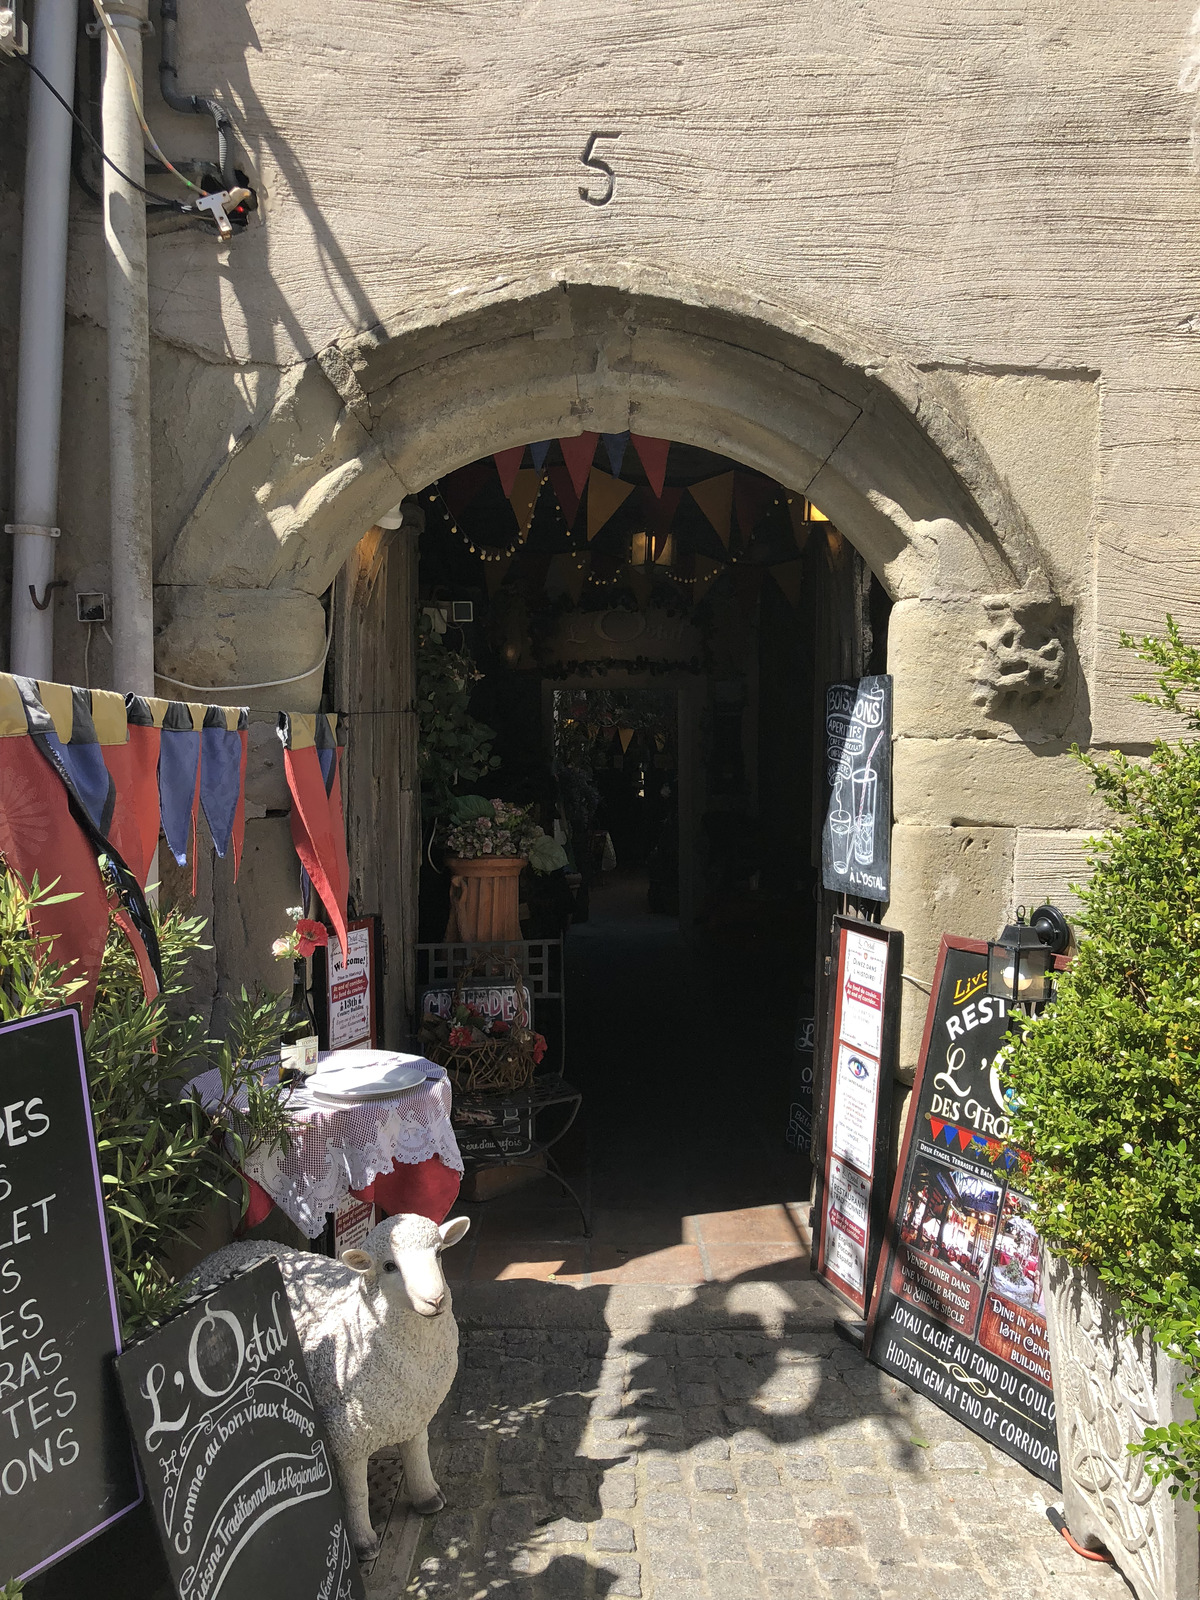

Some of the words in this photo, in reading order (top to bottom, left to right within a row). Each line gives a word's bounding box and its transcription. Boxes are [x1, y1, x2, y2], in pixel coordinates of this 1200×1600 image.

[578, 131, 623, 207] 5
[334, 956, 366, 972] Wecome!
[344, 996, 358, 1009] 13th
[0, 1098, 50, 1147] ES
[930, 1094, 961, 1121] DES
[833, 1183, 867, 1207] RESTAURANT
[901, 1265, 915, 1280] UNE
[916, 1273, 942, 1295] VIEILLE
[942, 1288, 971, 1311] BÂTISSE
[907, 1250, 928, 1271] VENEZ
[929, 1264, 950, 1284] DINER
[951, 1276, 971, 1294] DANS
[902, 1282, 913, 1295] DU
[940, 1304, 965, 1325] SIÈCLE
[990, 1297, 1016, 1323] DINE
[1016, 1315, 1027, 1329] IN
[1028, 1322, 1042, 1338] AN
[890, 1301, 923, 1335] JOYAU
[922, 1322, 956, 1356] CACHÉ
[953, 1343, 970, 1365] AU
[970, 1353, 999, 1385] FOND
[999, 1371, 1018, 1396] DU
[1018, 1383, 1057, 1421] COULO
[999, 1321, 1022, 1345] 13TH
[1023, 1336, 1051, 1361] CENT
[140, 1290, 290, 1453] L'Ostal
[1010, 1349, 1051, 1382] BUILDING
[2, 1377, 77, 1439] TES
[886, 1339, 923, 1375] HIDDEN
[922, 1367, 945, 1395] GEM
[944, 1384, 960, 1404] AT
[960, 1392, 982, 1420] END
[983, 1407, 999, 1430] OF
[999, 1419, 1059, 1472] CORRIDOR
[175, 1463, 207, 1555] Comme
[205, 1440, 221, 1466] au
[219, 1411, 245, 1443] bon
[244, 1399, 280, 1422] vieux
[282, 1398, 315, 1438] temps
[326, 1518, 342, 1571] Siècle
